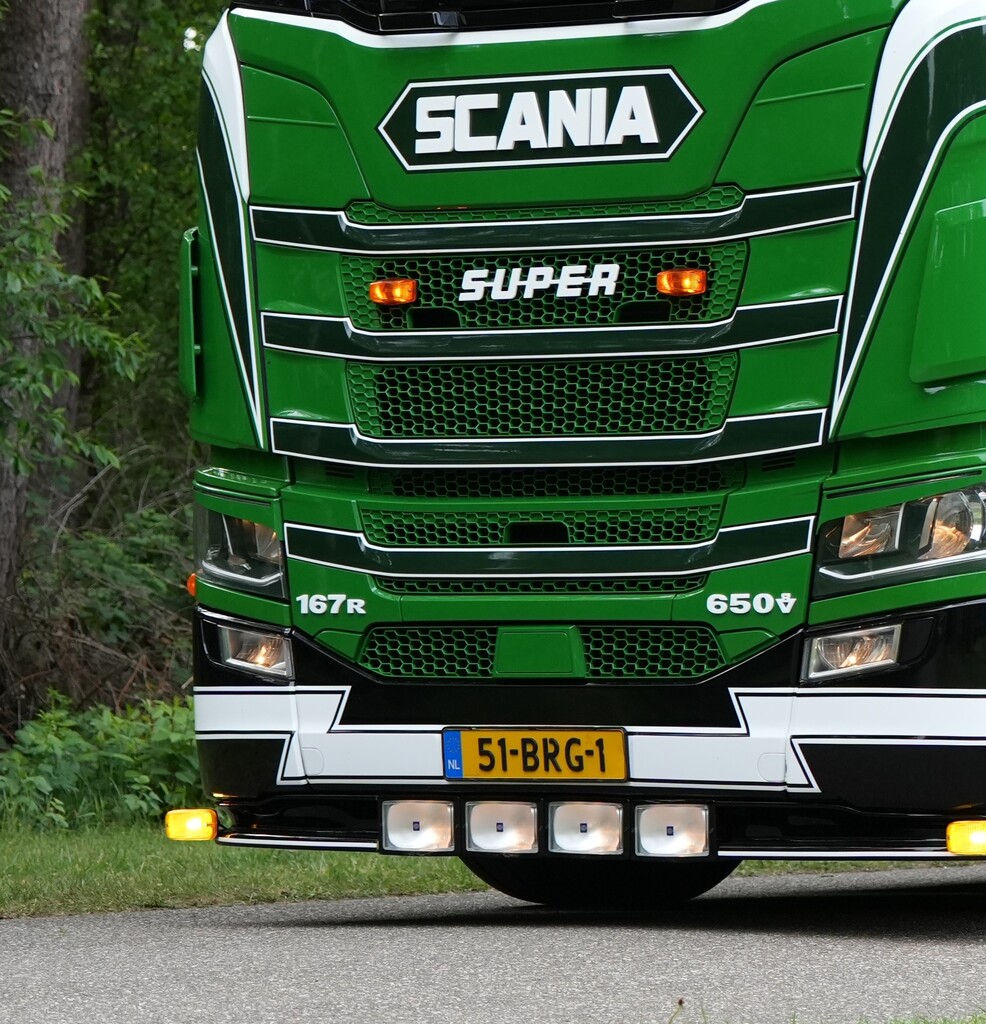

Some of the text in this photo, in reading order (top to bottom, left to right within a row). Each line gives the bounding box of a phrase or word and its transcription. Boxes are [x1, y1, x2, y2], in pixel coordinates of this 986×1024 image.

[414, 85, 660, 155] SCANIA
[458, 263, 620, 302] SUPER
[447, 759, 461, 771] NL
[477, 737, 606, 773] 51-BRG-1
